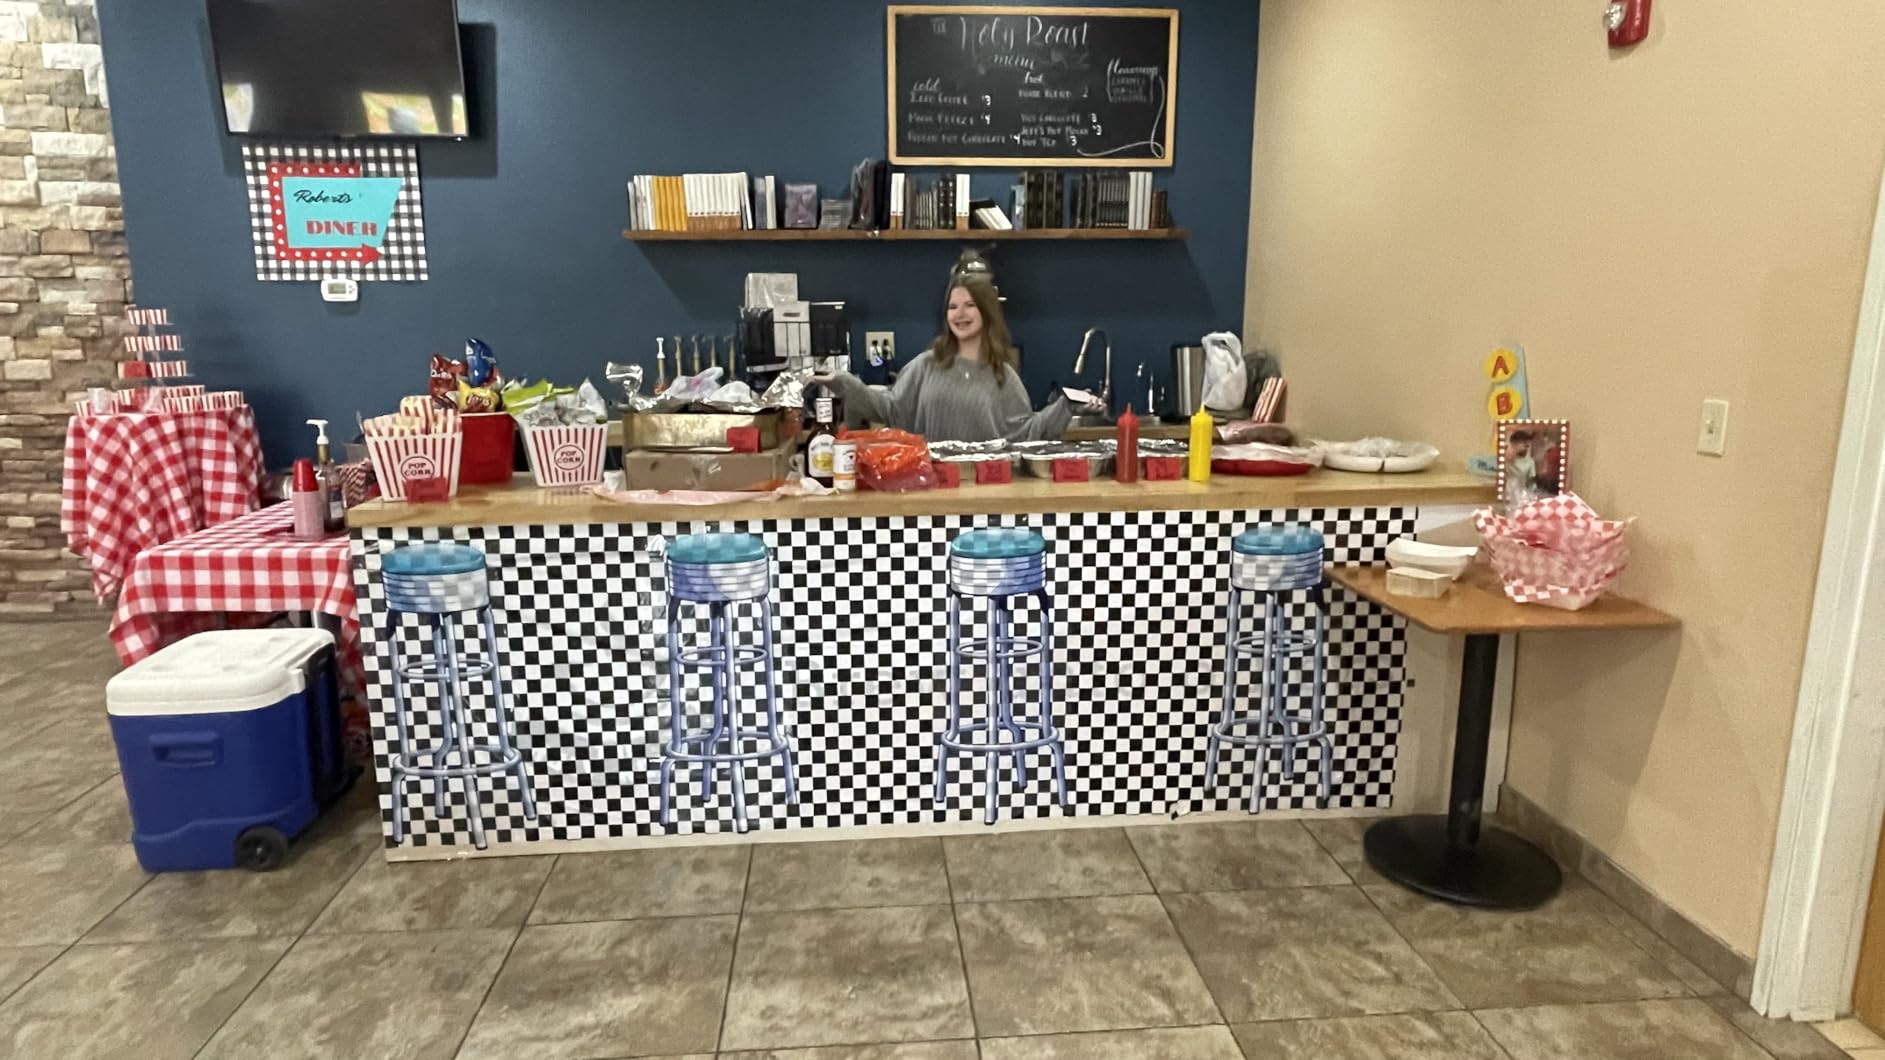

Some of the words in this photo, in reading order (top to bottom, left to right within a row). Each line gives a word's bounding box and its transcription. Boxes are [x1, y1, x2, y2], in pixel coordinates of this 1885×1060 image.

[959, 16, 1015, 55] Holy
[1027, 16, 1088, 48] Roast
[993, 53, 1035, 70] menu
[912, 77, 940, 92] cold
[306, 220, 378, 237] DINER
[1491, 355, 1511, 378] A
[1496, 391, 1513, 416] B
[404, 469, 432, 477] CORN
[408, 462, 427, 470] POP
